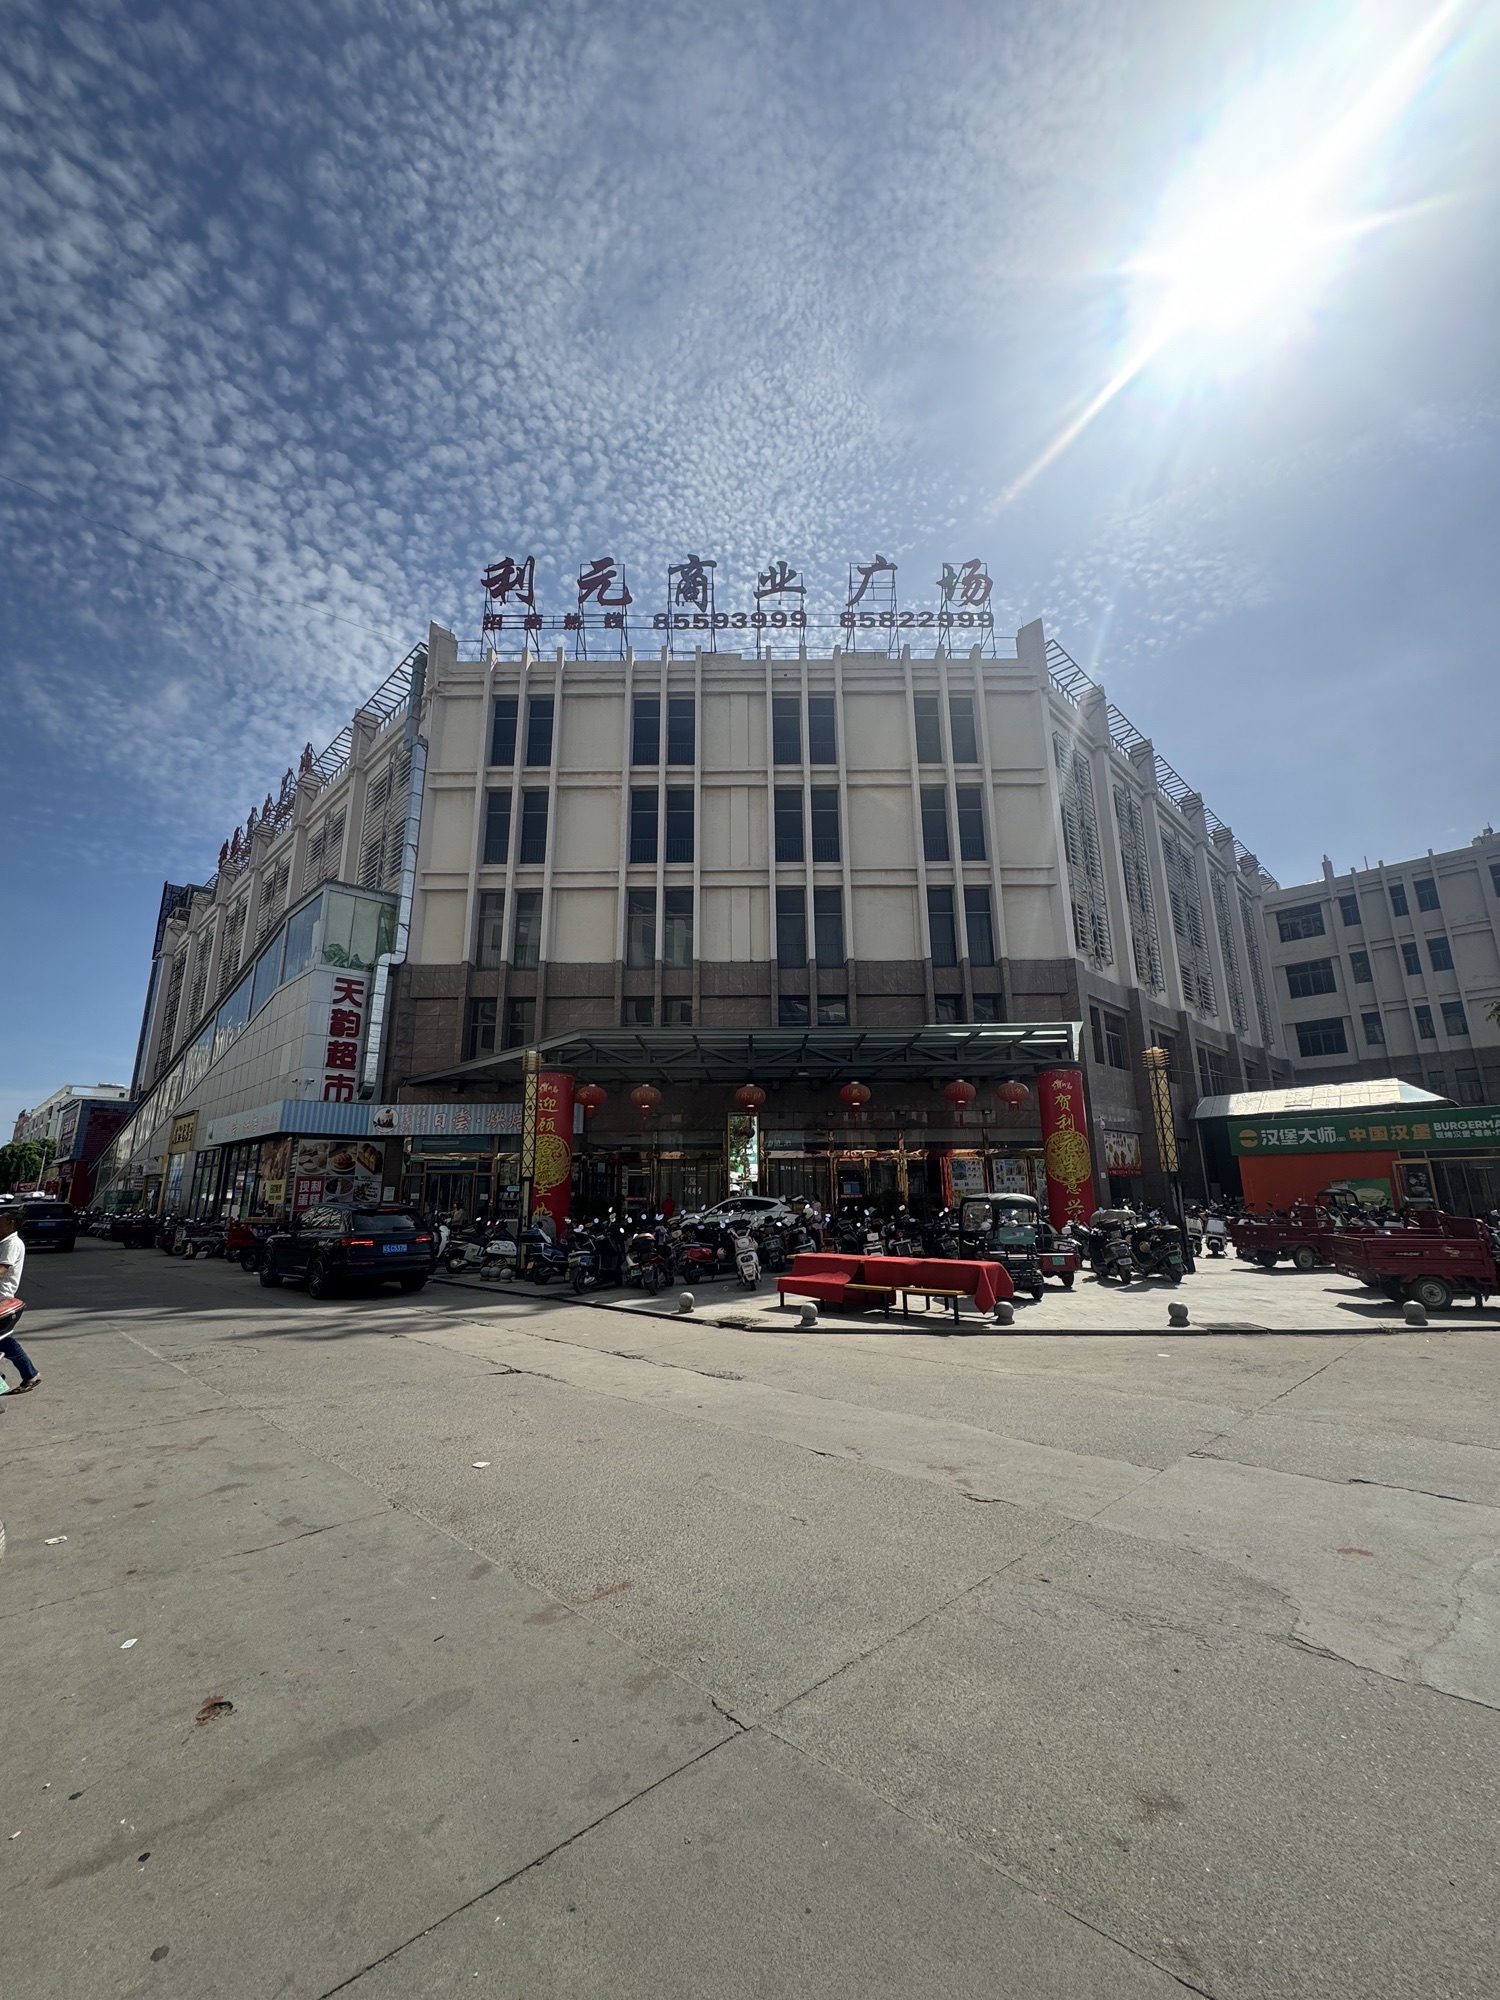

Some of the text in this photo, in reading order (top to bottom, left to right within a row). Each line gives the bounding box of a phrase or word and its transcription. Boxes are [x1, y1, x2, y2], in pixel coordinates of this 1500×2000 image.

[480, 554, 994, 612] 利元商业广场
[483, 611, 994, 631] 招商热线 85593999 85822999
[323, 976, 365, 1103] 天韵超市
[1260, 1126, 1336, 1146] 汉堡大师
[1348, 1122, 1432, 1142] 中国汉堡
[299, 1180, 322, 1193] 现制
[297, 1193, 321, 1206] 蛋糕
